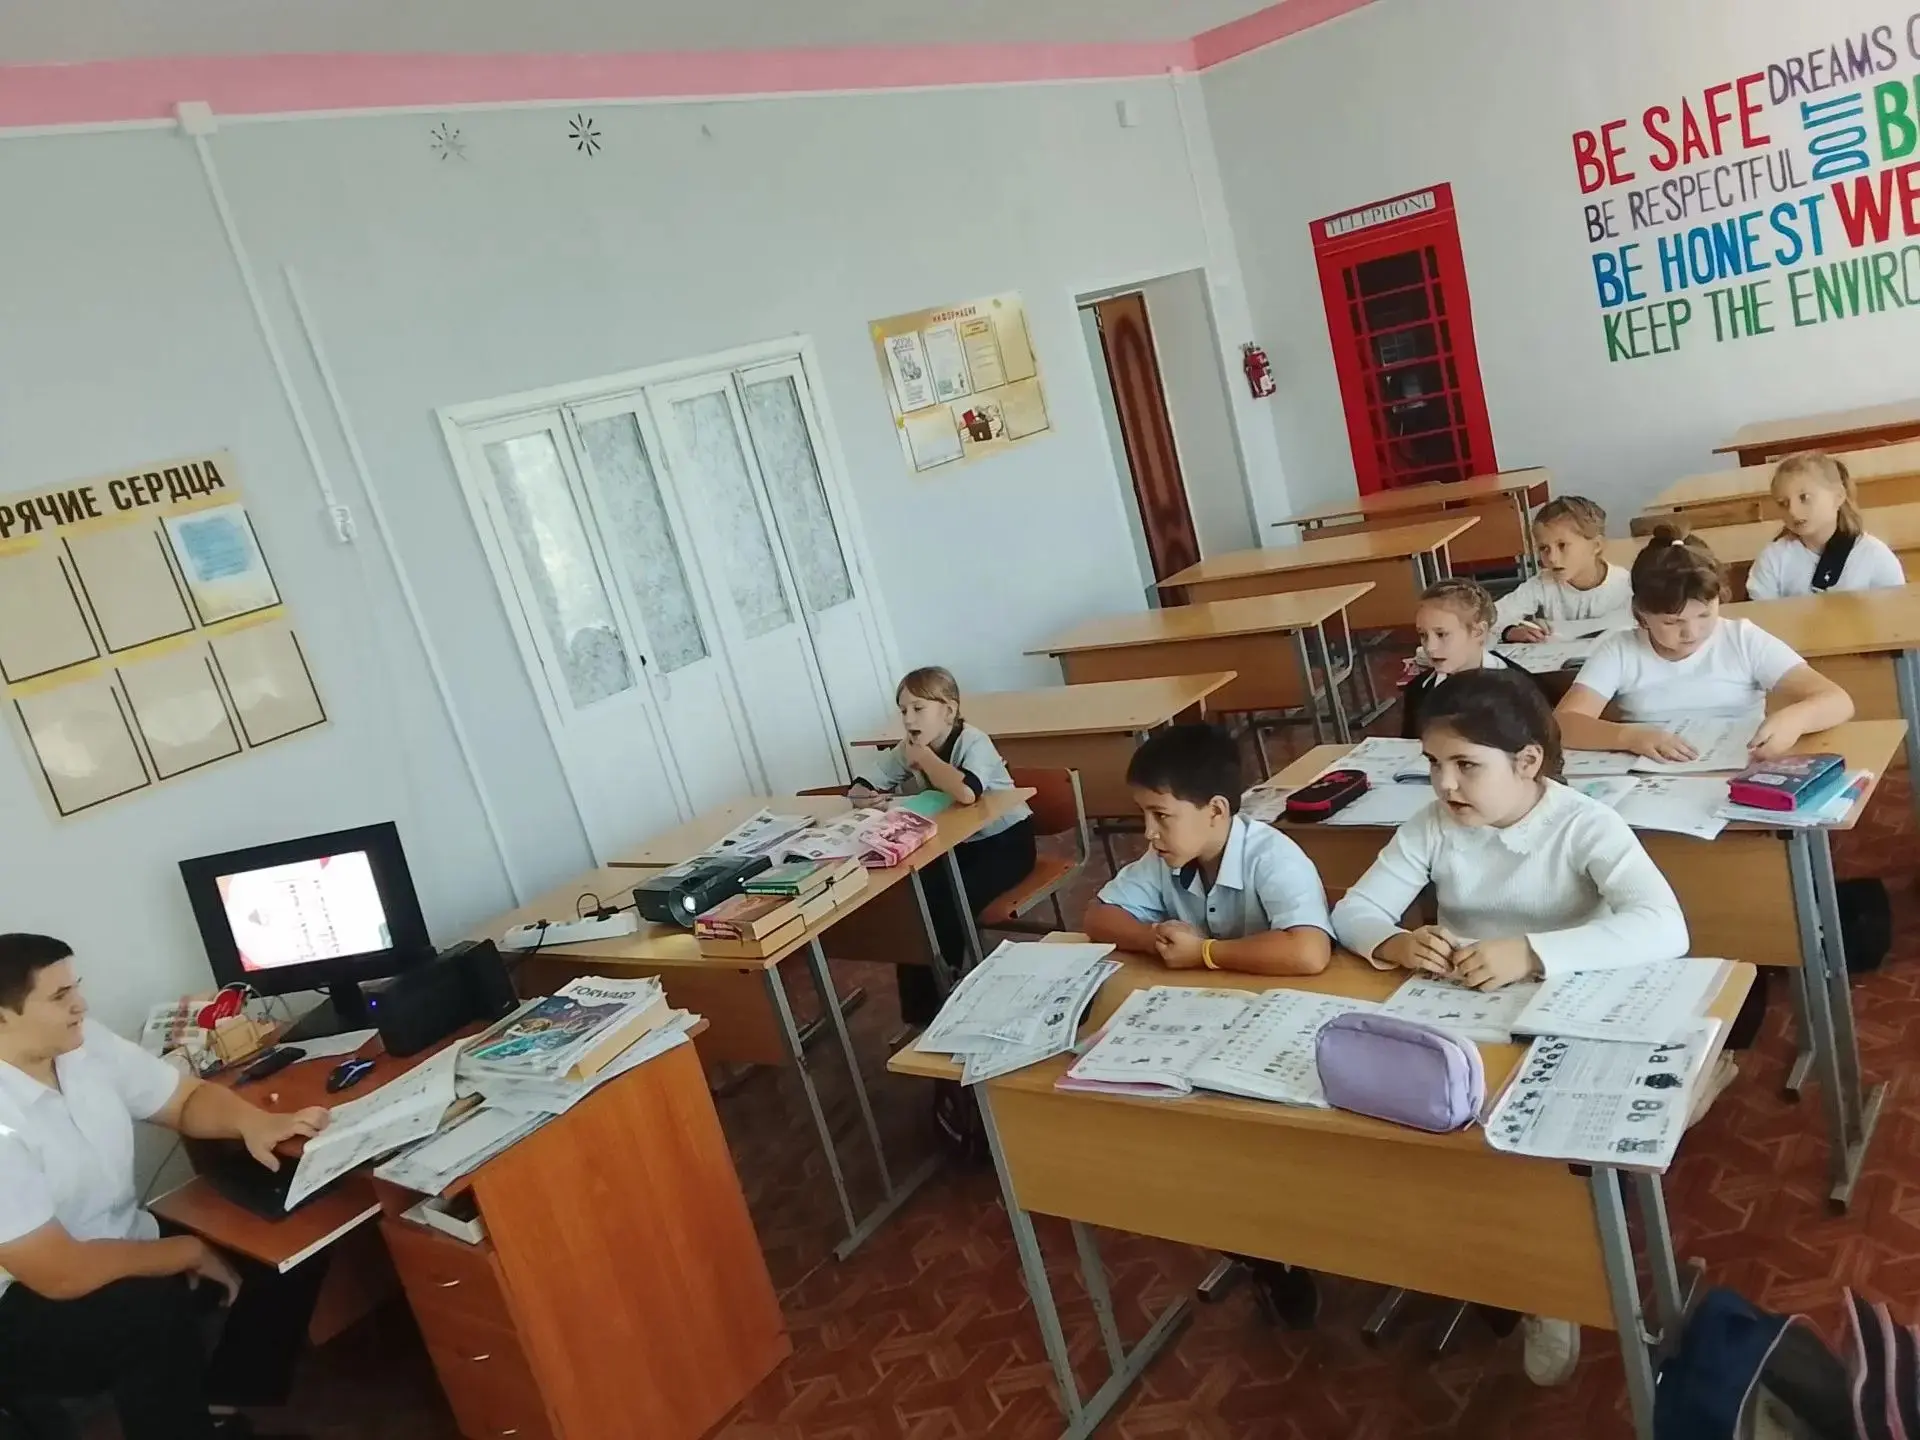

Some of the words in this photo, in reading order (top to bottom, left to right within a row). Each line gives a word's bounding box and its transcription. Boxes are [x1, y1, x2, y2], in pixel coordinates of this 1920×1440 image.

[1768, 25, 1897, 105] DREAMS
[1572, 119, 1636, 194] BE
[1642, 72, 1771, 172] SAFE
[1328, 194, 1433, 234] TELEPHONE
[1584, 199, 1619, 243] BE
[1628, 148, 1807, 230] RESPECTFUL
[1592, 243, 1647, 308] BE
[1658, 193, 1825, 293] HONEST
[1603, 298, 1692, 362] KEEP
[1704, 279, 1775, 342] THE
[0, 486, 102, 538] РЯЧИЕ
[108, 460, 225, 510] СЕРДЦА
[570, 985, 636, 999] FORWARD
